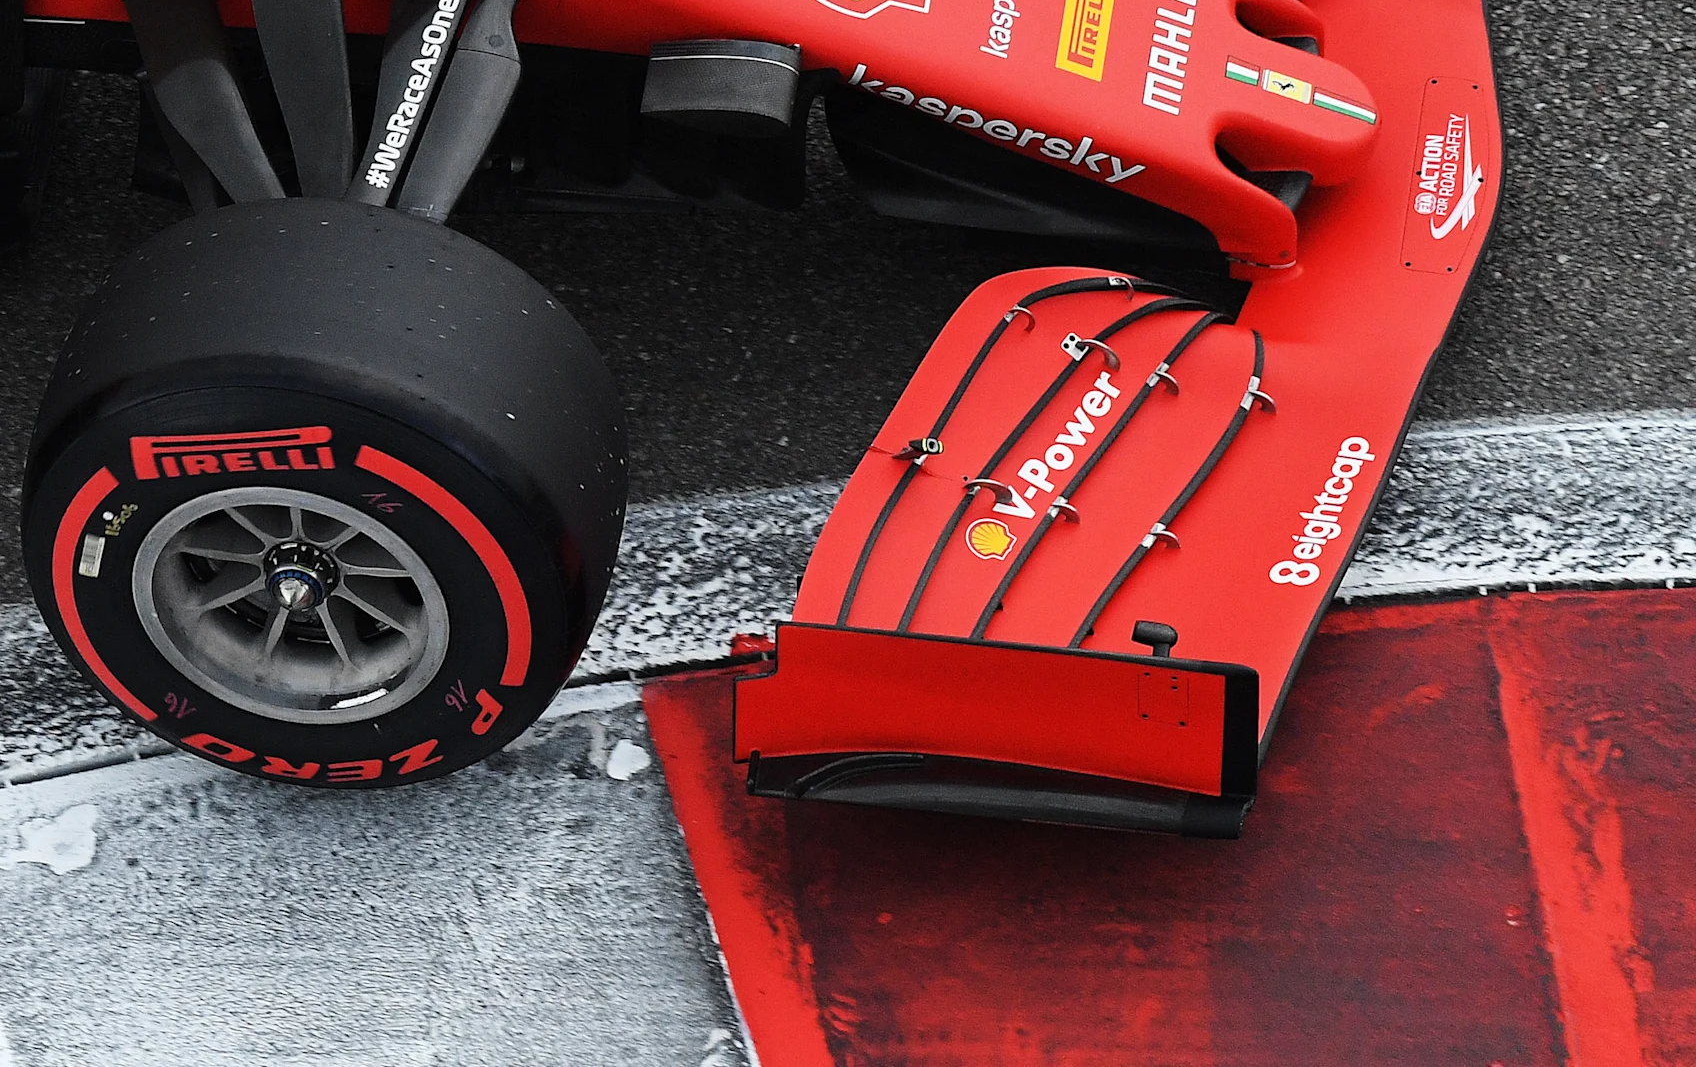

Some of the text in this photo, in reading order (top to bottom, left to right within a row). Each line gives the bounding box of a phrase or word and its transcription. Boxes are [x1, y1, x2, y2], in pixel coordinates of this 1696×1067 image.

[848, 63, 1146, 184] kaspersky
[1418, 134, 1445, 193] ACTION
[1435, 113, 1465, 216] FOR ROAD SAFETY
[129, 425, 335, 480] PIRELLI
[992, 370, 1121, 520] V-Power
[181, 688, 504, 782] P ZERO
